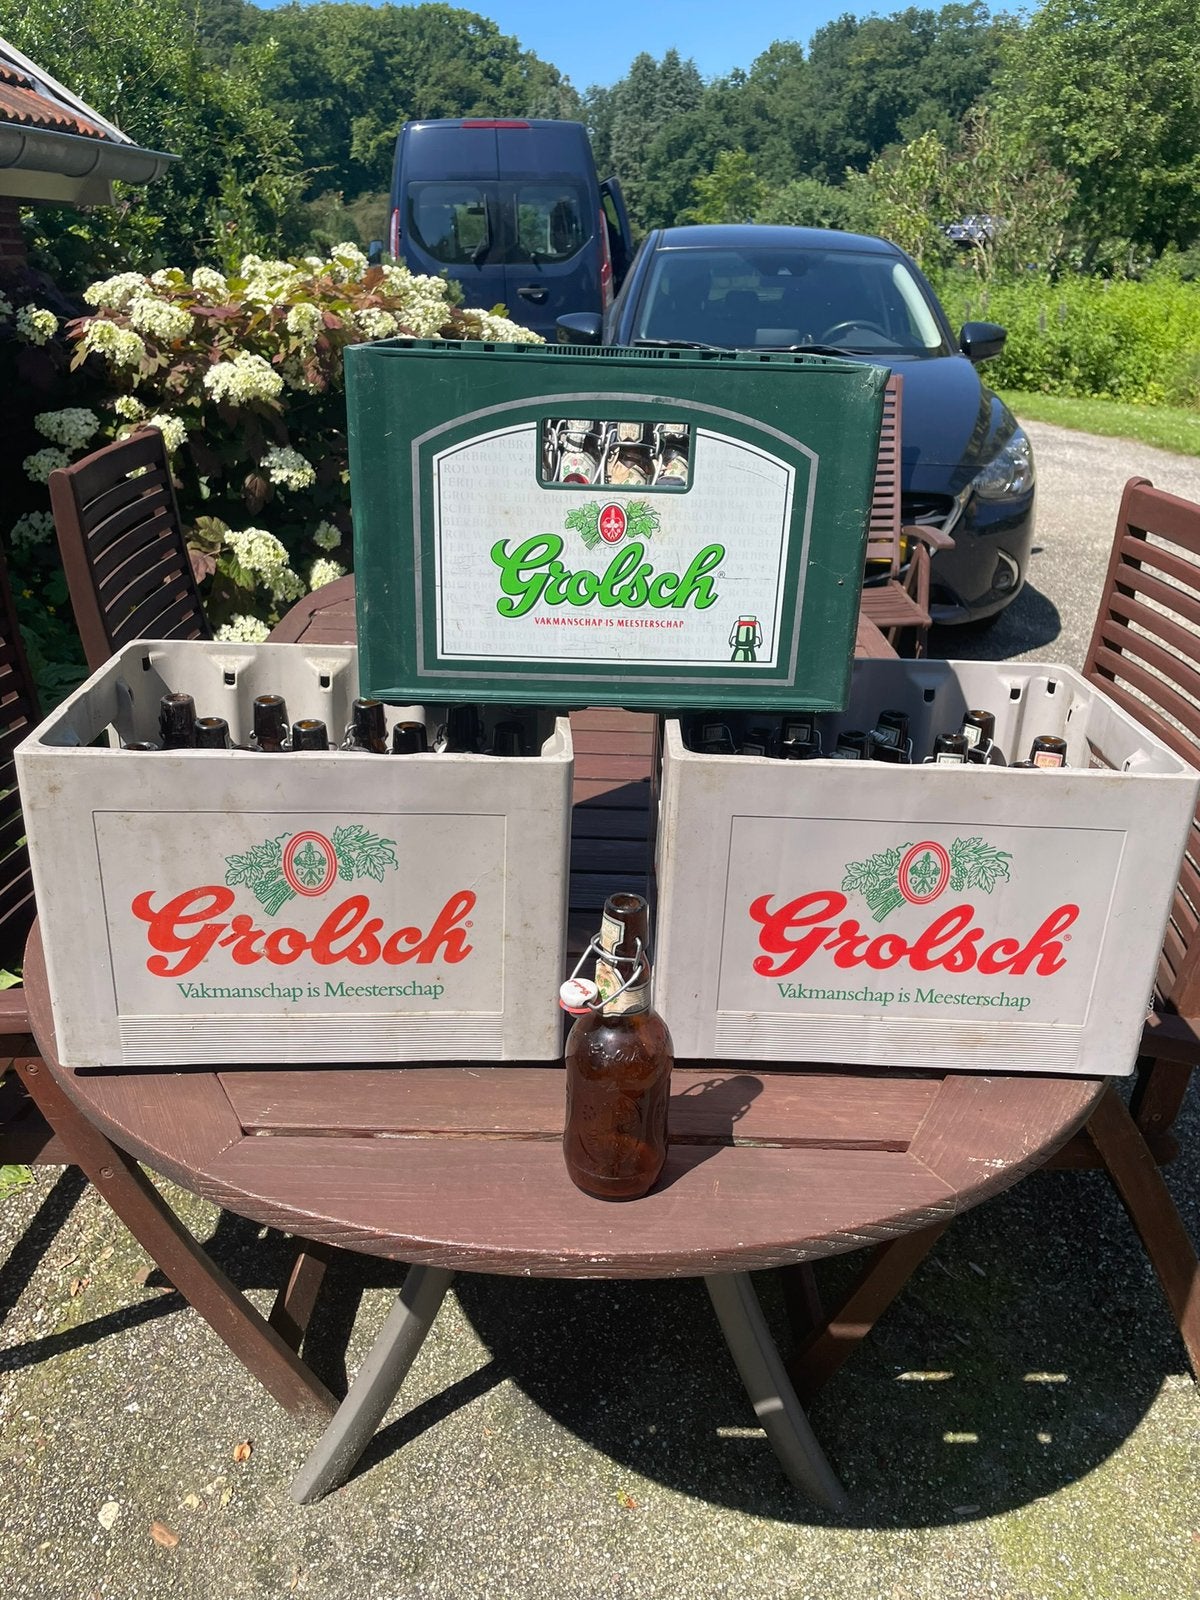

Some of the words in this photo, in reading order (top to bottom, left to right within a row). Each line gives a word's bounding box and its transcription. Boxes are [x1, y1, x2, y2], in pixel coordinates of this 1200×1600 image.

[491, 532, 724, 618] Grolsch
[534, 617, 603, 627] VAKMANSCHAP
[605, 618, 614, 627] IS
[617, 619, 685, 629] MEESTERSCHAP
[131, 885, 477, 977] Grolsch
[749, 890, 1080, 977] Grolsch
[177, 982, 303, 1001] Vakmanschap
[307, 981, 320, 997] is
[324, 979, 445, 1000] Meesterschap
[777, 982, 895, 1005] Vakmanschap
[898, 987, 910, 1004] is
[914, 987, 1031, 1010] Meesterschap
